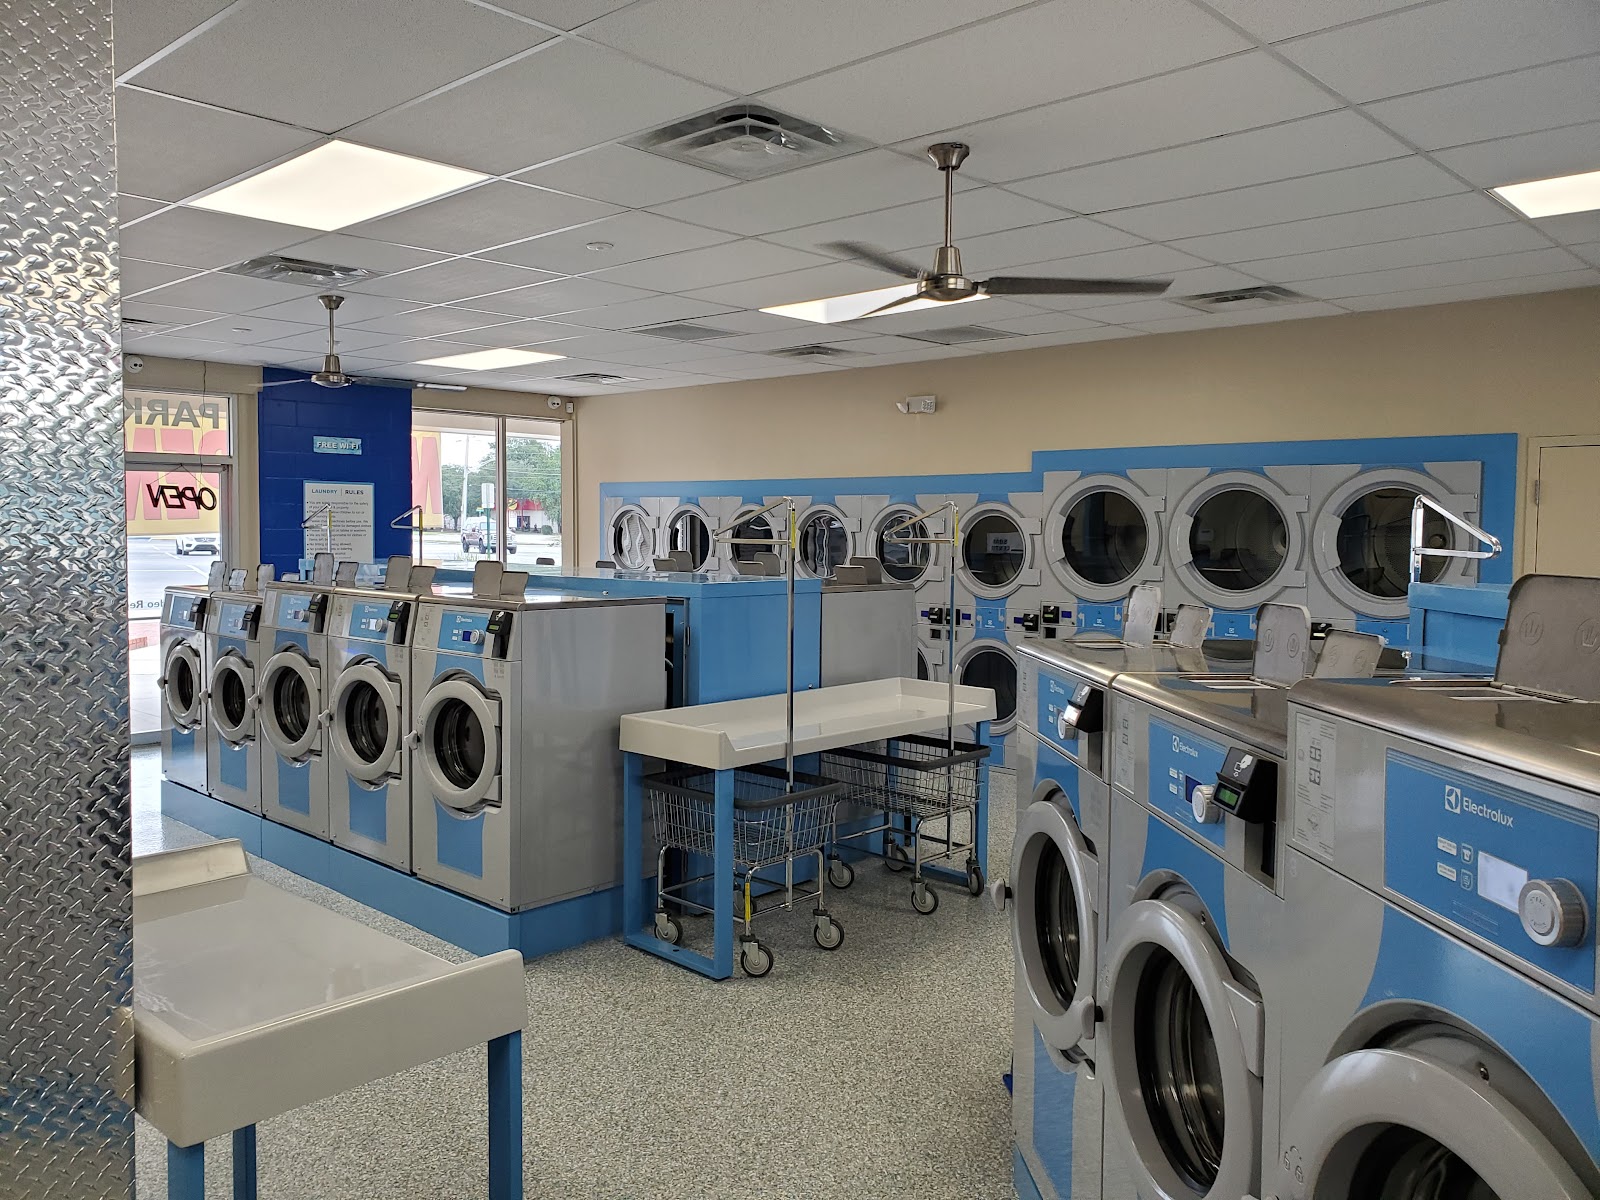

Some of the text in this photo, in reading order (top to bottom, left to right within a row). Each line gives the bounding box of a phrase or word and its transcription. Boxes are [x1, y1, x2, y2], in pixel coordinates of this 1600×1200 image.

[316, 441, 360, 450] FREE WI-FI
[1462, 797, 1514, 828] Electrolux
